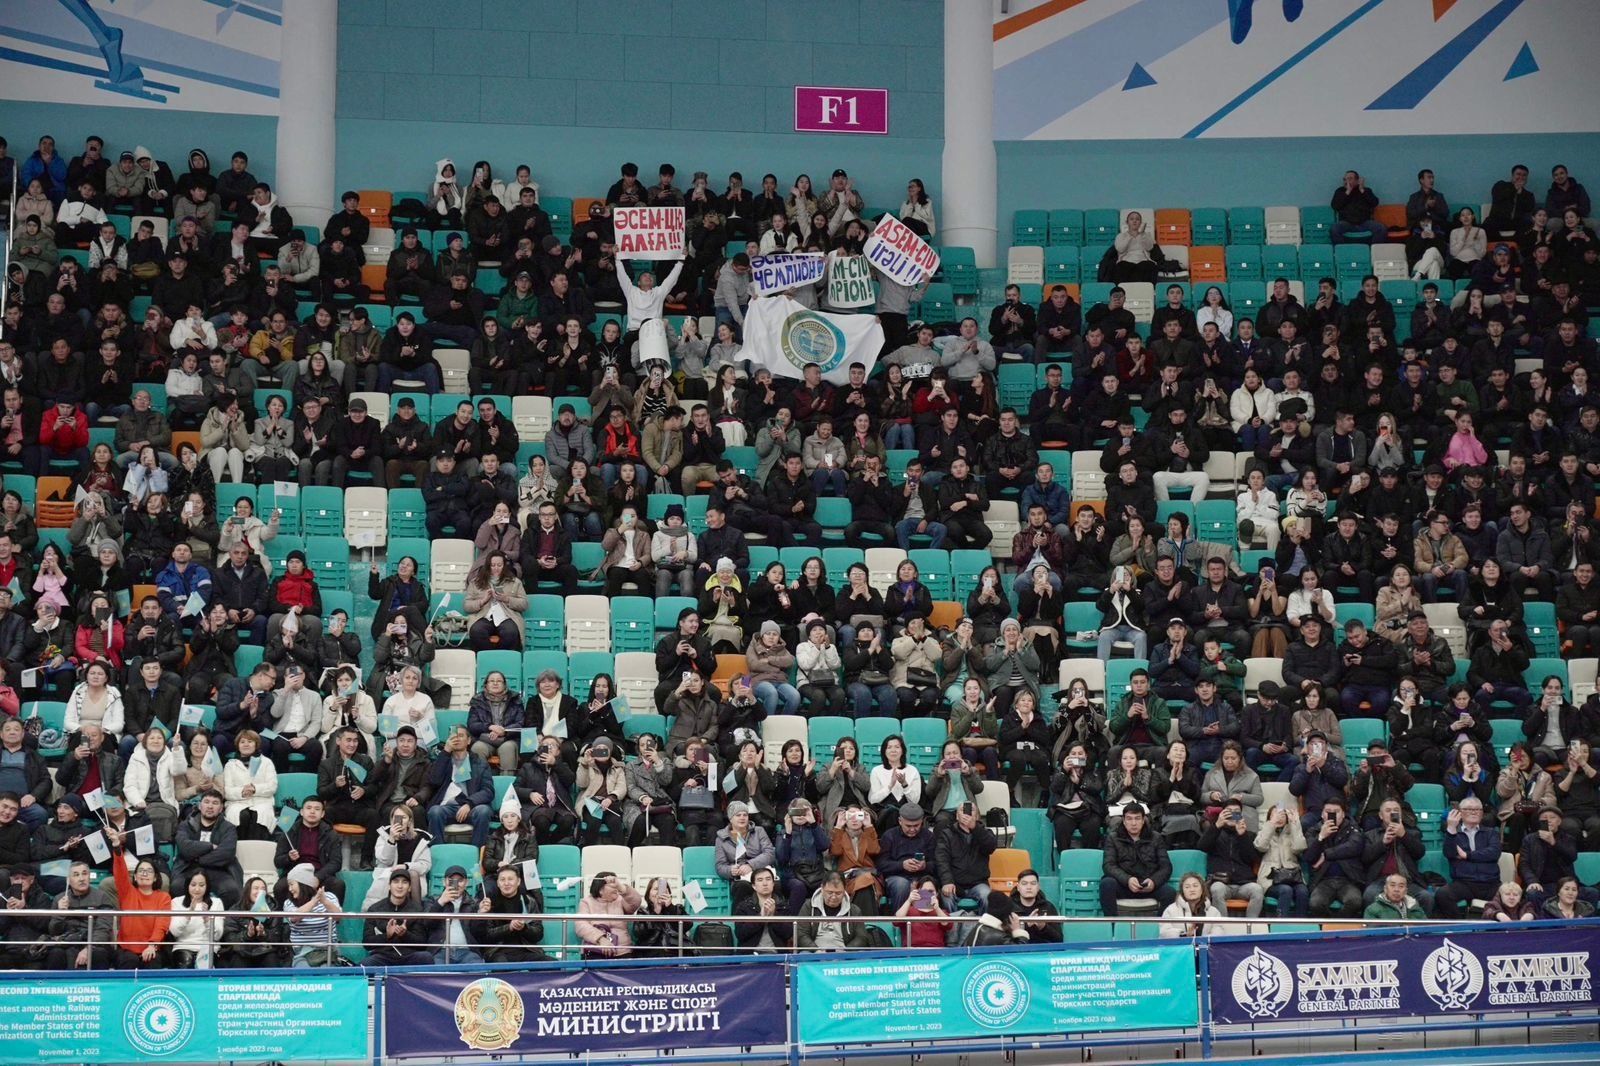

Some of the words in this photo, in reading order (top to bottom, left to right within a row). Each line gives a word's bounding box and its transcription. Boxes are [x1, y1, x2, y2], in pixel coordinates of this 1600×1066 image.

[818, 95, 860, 125] F1
[1050, 957, 1082, 966] ВТОРАЯ
[1083, 953, 1159, 964] МЕЖДУНАРОДНАЯ
[823, 968, 838, 976] THE
[840, 967, 872, 976] SECOND
[873, 964, 939, 973] INTERNATIONAL
[1050, 965, 1110, 974] СПАРТАКИАДА
[1487, 955, 1591, 980] SAMRUK
[908, 972, 939, 980] SPORTS
[1051, 976, 1074, 984] среди
[1076, 972, 1152, 982] железнодорожных
[1297, 963, 1399, 987] SAMRUK
[30, 986, 100, 994] INTERNATIONAL
[218, 984, 252, 992] ВТОРАЯ
[253, 983, 332, 992] МЕЖДУНАРОДНАЯ
[836, 984, 865, 992] contest
[866, 984, 893, 992] among
[910, 981, 940, 989] Railway
[1052, 982, 1116, 991] администраций
[540, 987, 613, 1000] ҚАЗАҚСТАН
[617, 983, 716, 996] РЕСПУБЛИКАСЫ
[878, 990, 940, 999] Administrations
[1052, 991, 1116, 1001] стран-участниц
[1117, 988, 1171, 997] Организации
[66, 995, 100, 1003] SPORTS
[218, 993, 280, 1002] СПАРТАКИАДА
[1488, 992, 1539, 1005] GENERAL
[1540, 990, 1592, 1003] PARTNER
[245, 1002, 323, 1010] железнодорожных
[539, 1000, 621, 1015] МӘДЕНИЕТ
[624, 999, 668, 1011] ЖӘНЕ
[671, 997, 717, 1009] СПОРТ
[832, 1002, 841, 1010] of
[843, 1001, 856, 1009] the
[858, 1000, 889, 1009] Member
[891, 999, 916, 1007] States
[918, 998, 926, 1006] of
[1052, 1000, 1091, 1009] Тюркских
[1093, 999, 1137, 1007] государств
[1298, 1000, 1348, 1012] GENERAL
[1349, 998, 1400, 1010] PARTNER
[22, 1006, 50, 1014] among
[52, 1004, 66, 1012] the
[68, 1004, 100, 1013] Railway
[829, 1010, 879, 1019] Organization
[881, 1008, 889, 1016] of
[890, 1007, 914, 1015] Turkic
[916, 1006, 941, 1014] States
[218, 1011, 285, 1019] администраций
[218, 1020, 284, 1028] стран-участниц
[286, 1019, 341, 1027] Организации
[537, 1011, 721, 1036] МИНИСТРЛІГІ
[1059, 1017, 1082, 1025] ноября
[11, 1023, 45, 1031] Member
[47, 1022, 73, 1030] States
[885, 1024, 918, 1032] November
[35, 1031, 44, 1039] of
[45, 1031, 71, 1039] Turkic
[73, 1031, 100, 1039] States
[218, 1029, 257, 1037] Тюркских
[260, 1029, 306, 1037] государств
[39, 1048, 74, 1056] November
